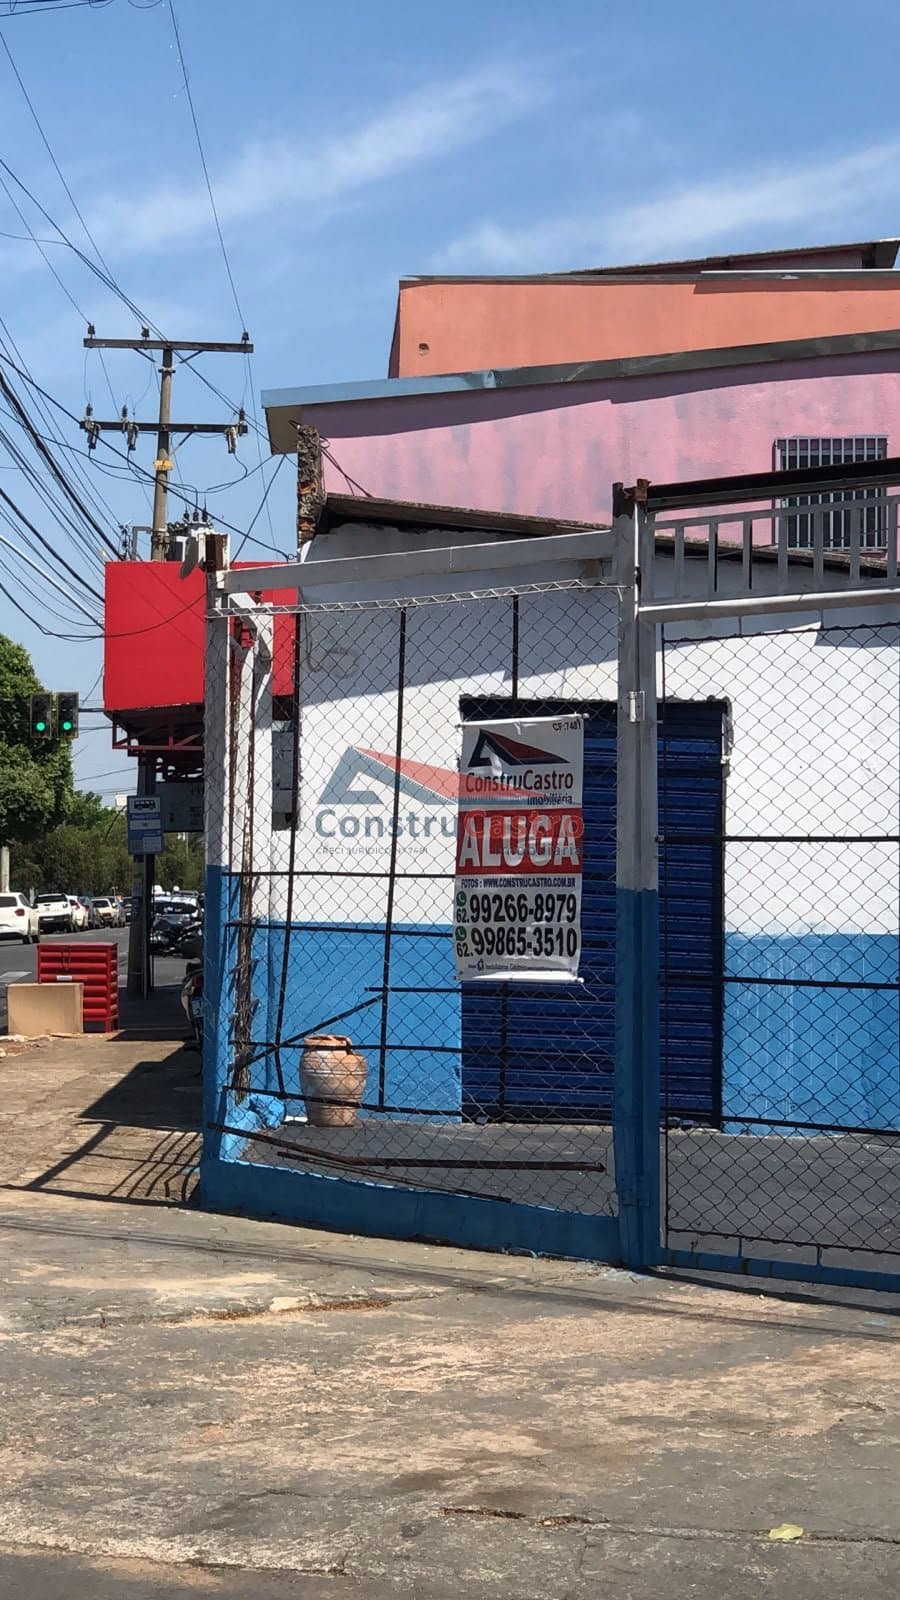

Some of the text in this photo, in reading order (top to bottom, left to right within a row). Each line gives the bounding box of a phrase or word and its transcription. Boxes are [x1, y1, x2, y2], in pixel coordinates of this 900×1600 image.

[465, 769, 574, 793] ConstruCastro
[458, 814, 580, 867] ALUGA
[483, 877, 576, 888] WWW.CONSTRUCASTRO.COM.BR
